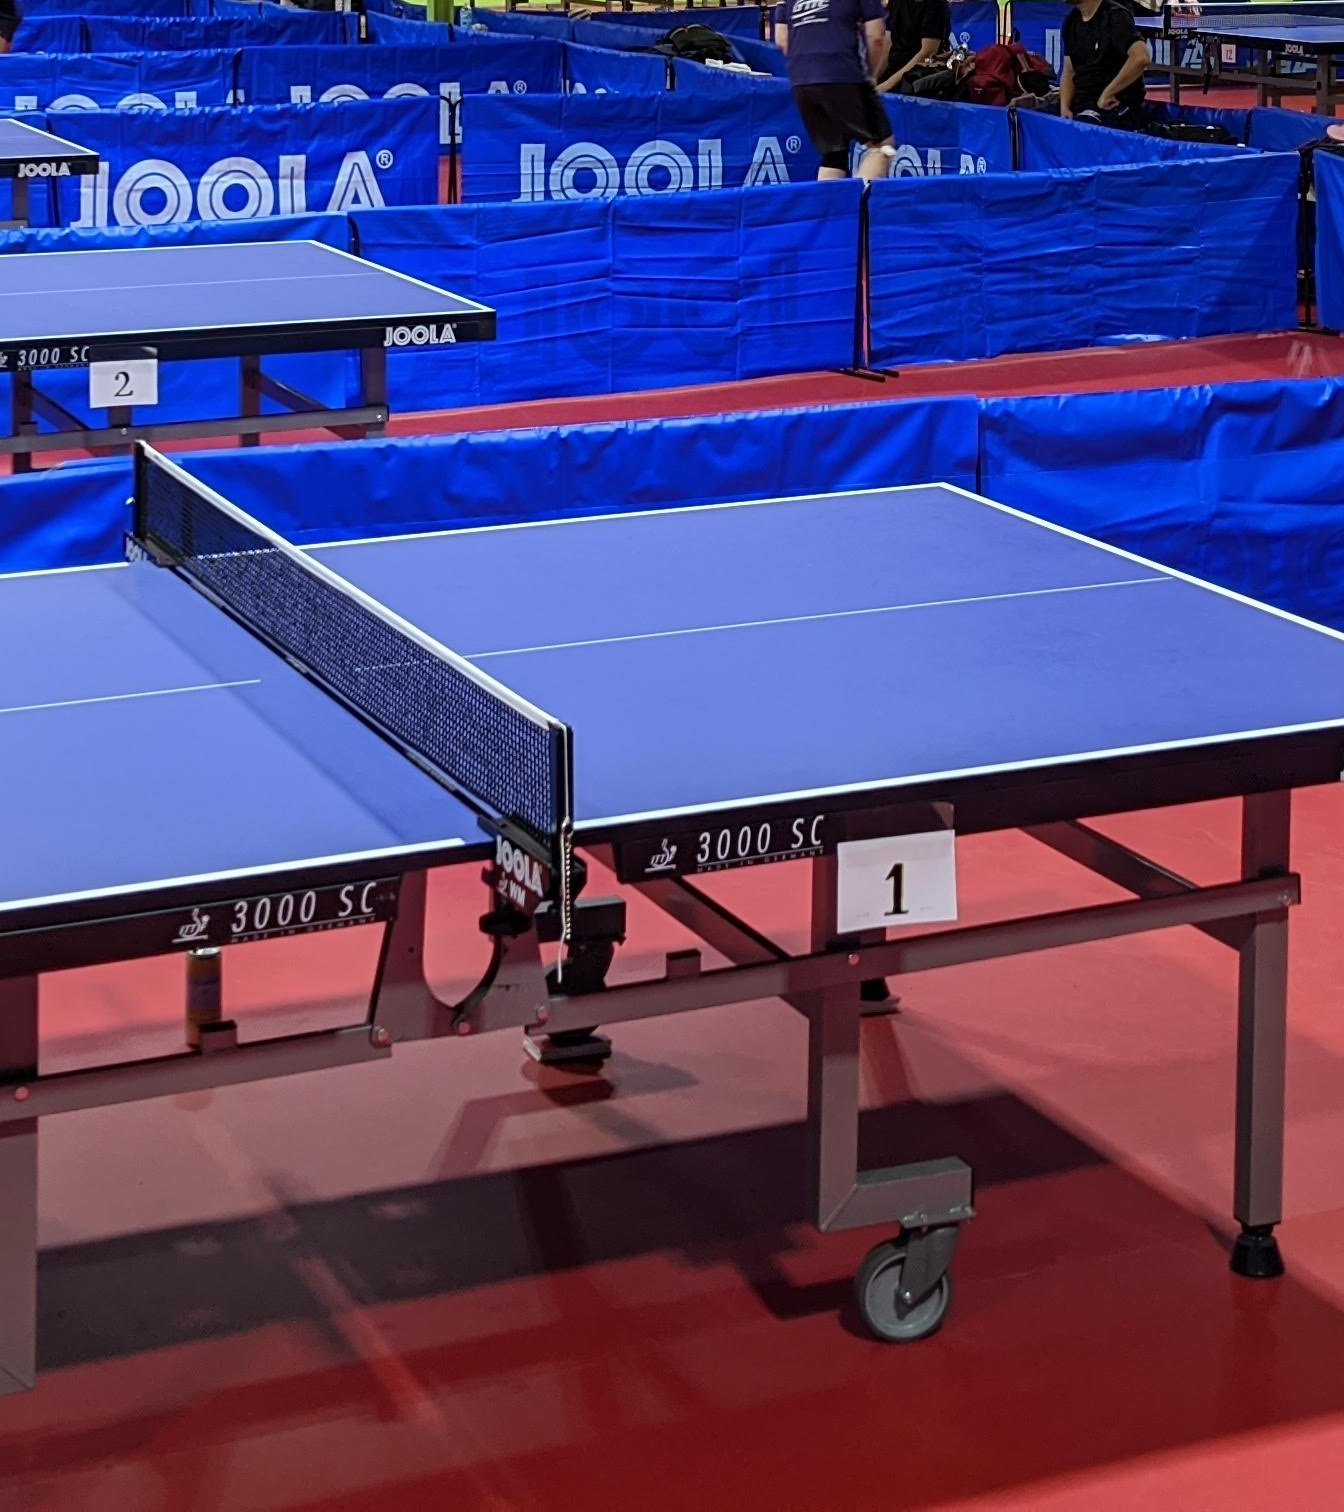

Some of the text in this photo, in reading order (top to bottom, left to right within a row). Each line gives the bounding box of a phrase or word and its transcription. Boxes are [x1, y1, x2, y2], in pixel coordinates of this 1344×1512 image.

[18, 162, 71, 178] JOOLA
[383, 324, 456, 346] JOOLA
[17, 346, 90, 366] 3000 SC
[114, 371, 133, 397] 2
[697, 815, 824, 863] 3000 SC
[496, 834, 543, 898] JOOLA
[231, 882, 376, 933] 3000 SC
[884, 863, 908, 916] 1
